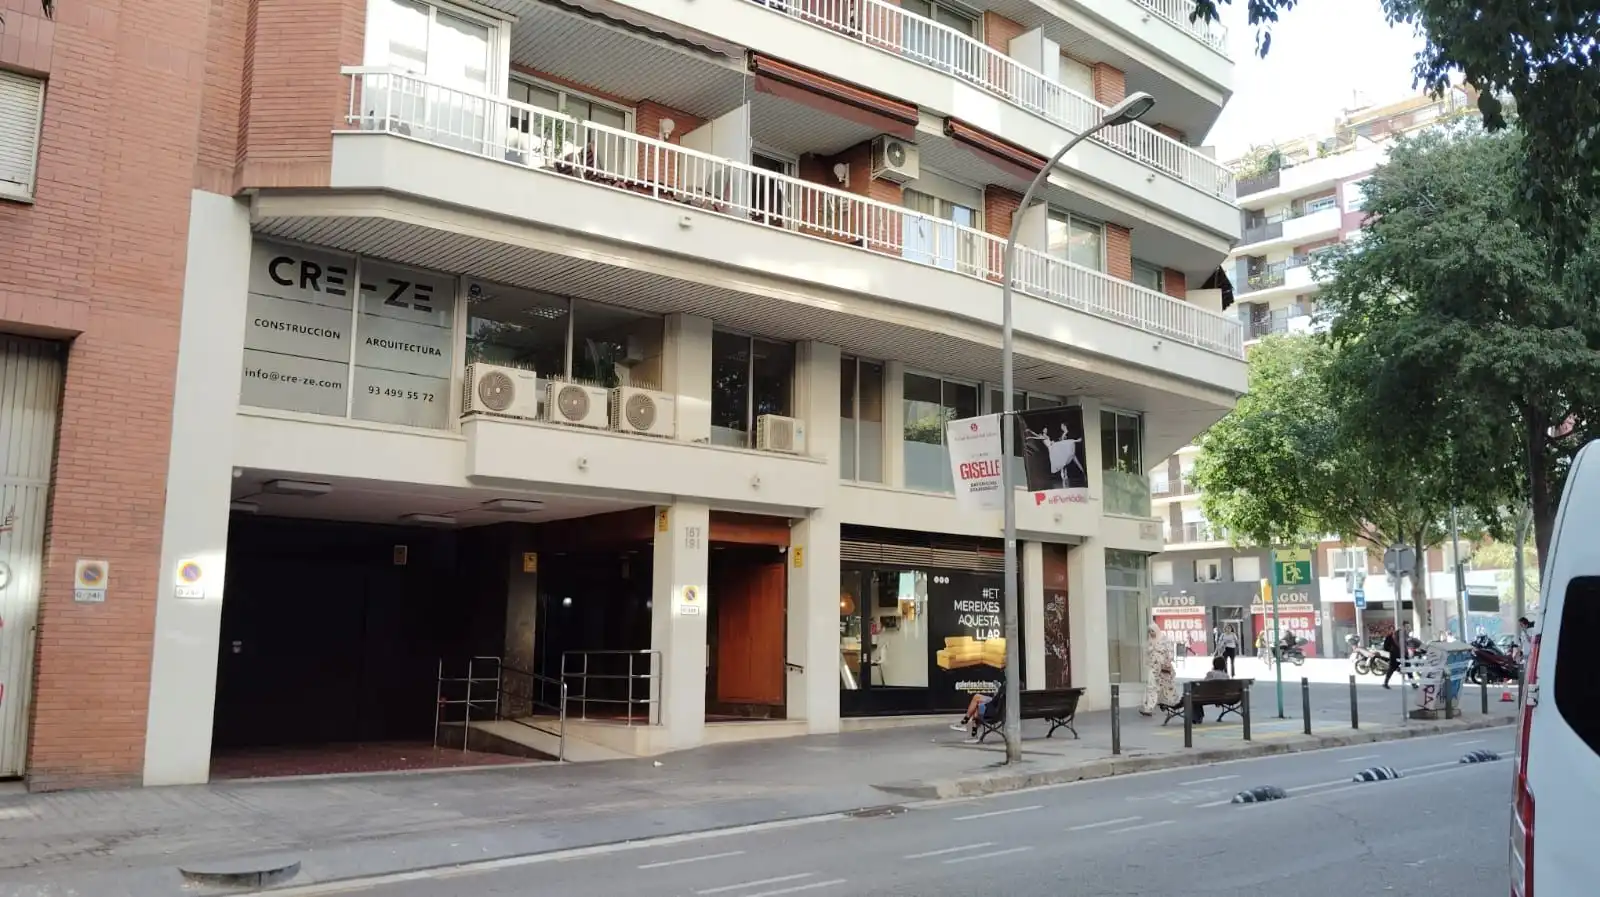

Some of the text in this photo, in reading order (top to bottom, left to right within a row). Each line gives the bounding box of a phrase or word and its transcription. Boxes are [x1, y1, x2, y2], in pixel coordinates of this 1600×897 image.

[365, 337, 442, 357] ARQUITECTURA
[245, 368, 342, 389] info@cre-ze.com
[368, 386, 434, 402] 93 499 55 72
[960, 459, 1001, 480] GISELLE
[982, 588, 999, 600] #ET
[1157, 592, 1308, 606] AUTOS AGON
[954, 600, 1000, 613] MEREIXES
[958, 615, 1000, 627] AQUESTA
[976, 629, 1000, 640] LLAR
